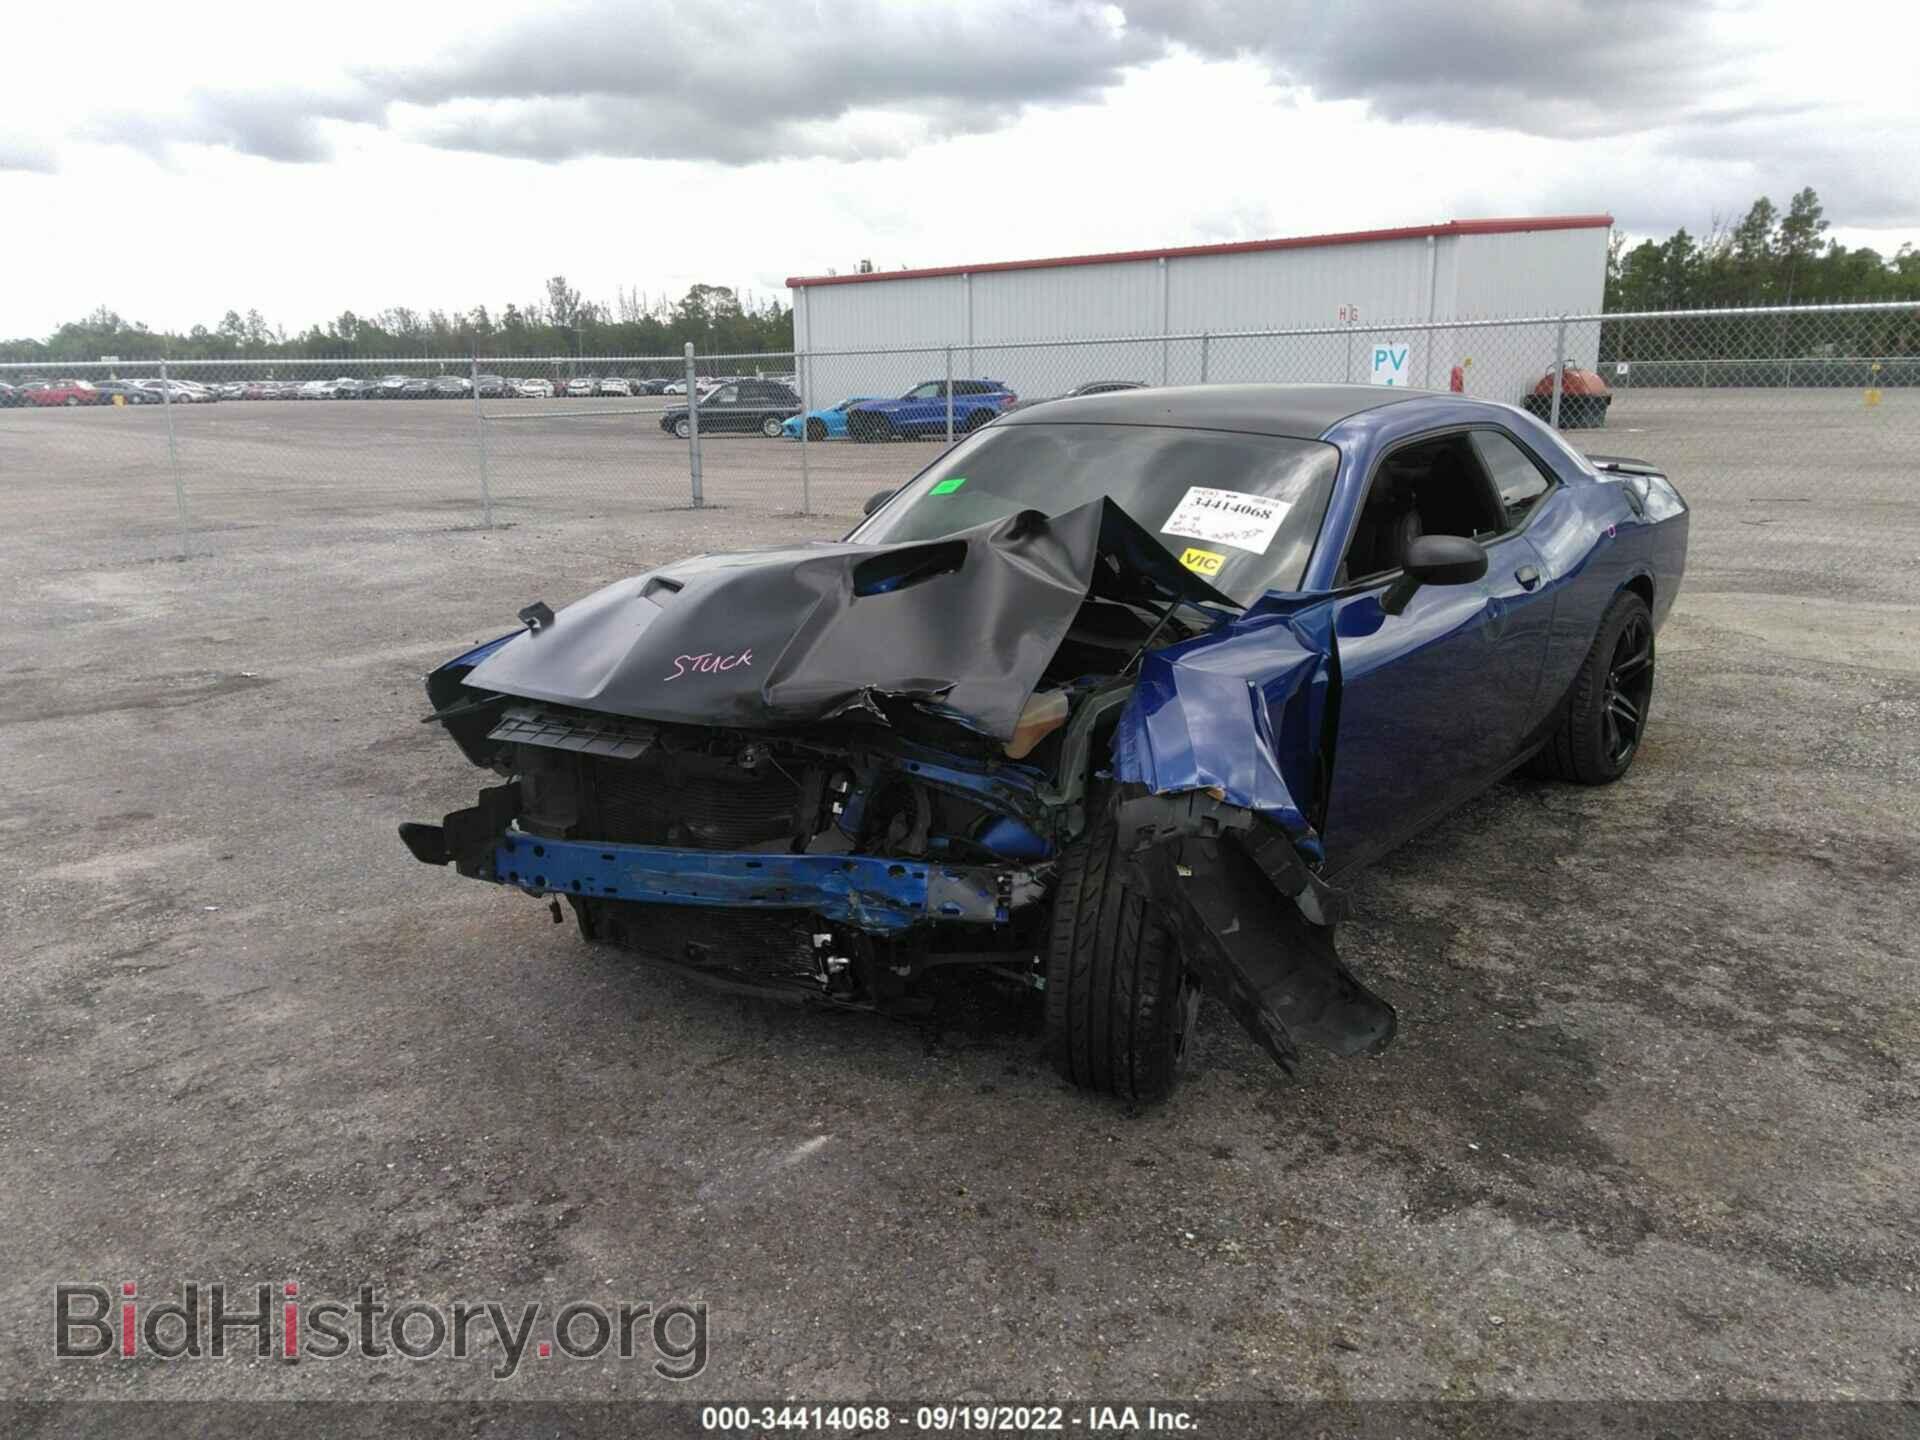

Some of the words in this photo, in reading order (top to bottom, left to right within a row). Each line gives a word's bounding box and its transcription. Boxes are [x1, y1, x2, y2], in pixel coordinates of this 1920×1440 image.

[1375, 350, 1407, 371] PV
[1191, 497, 1272, 519] 34414068
[1186, 553, 1218, 570] VIC
[663, 648, 753, 682] STUCK
